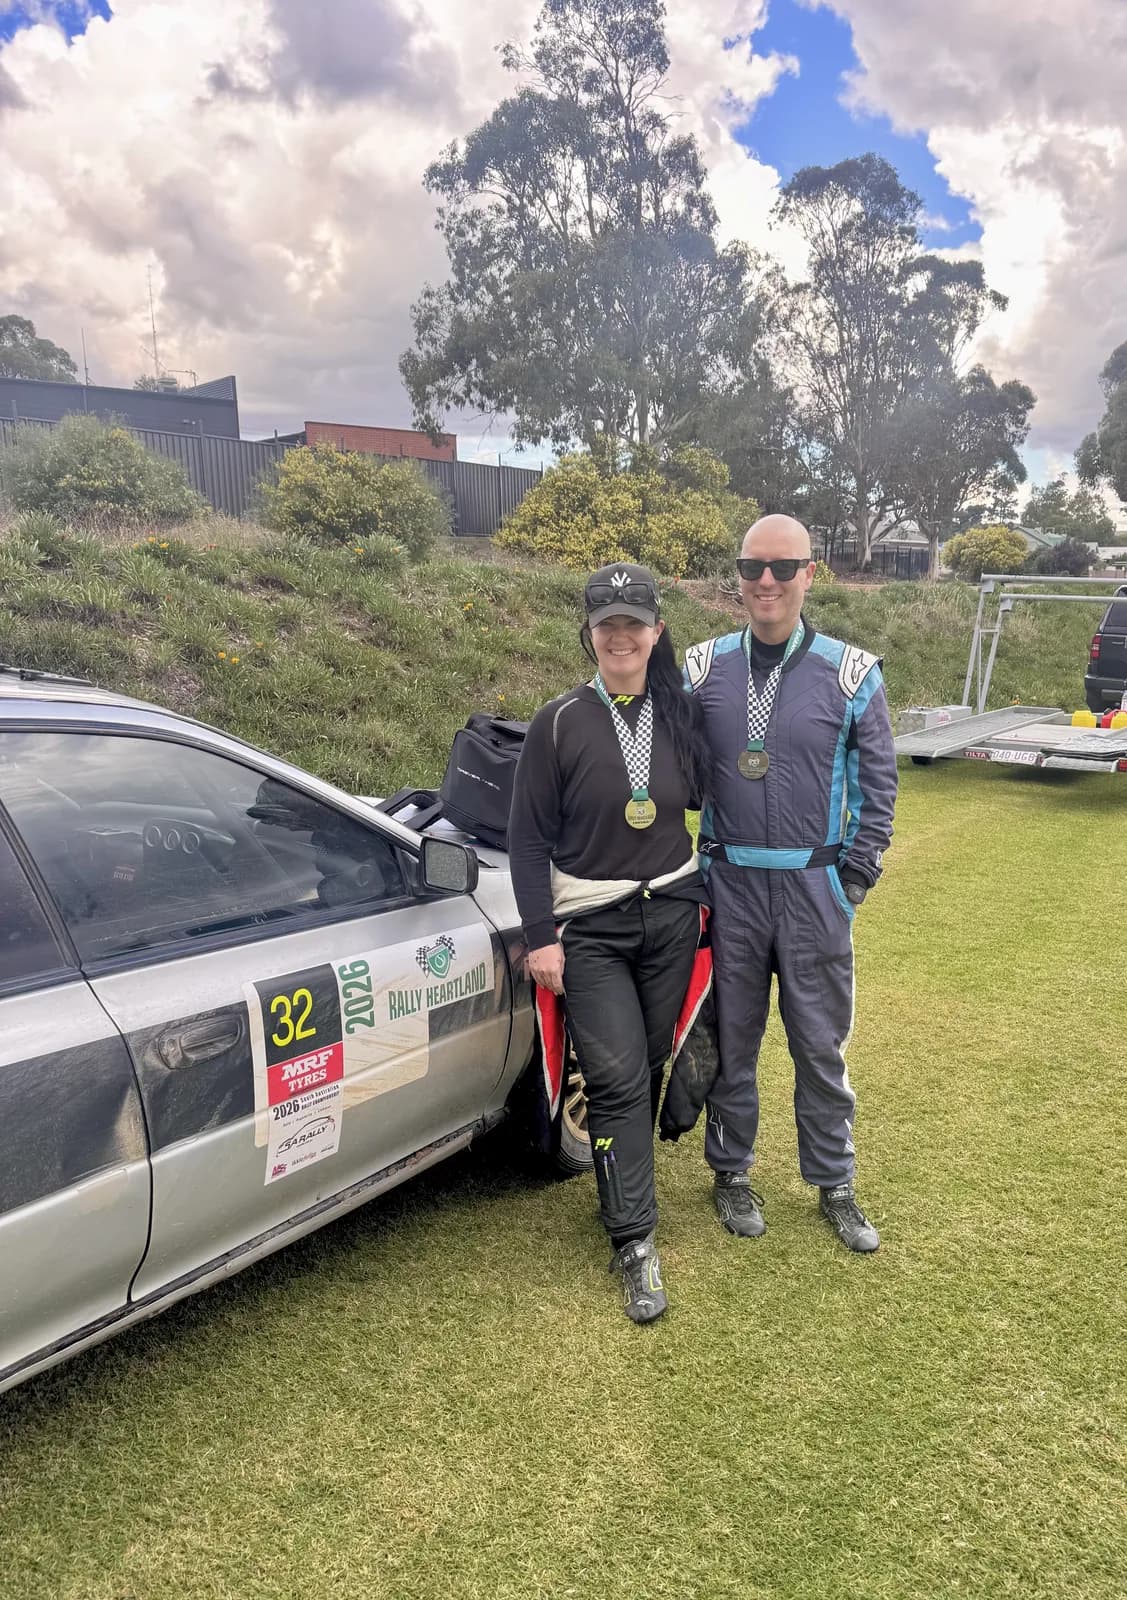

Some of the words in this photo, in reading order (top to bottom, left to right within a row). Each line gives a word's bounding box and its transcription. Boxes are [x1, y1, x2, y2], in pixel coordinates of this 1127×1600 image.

[964, 751, 986, 759] TILTA
[338, 959, 376, 1035] 2026
[388, 988, 423, 1021] RALLY
[426, 962, 486, 1008] HEARTLAND
[270, 987, 317, 1047] 32
[281, 1049, 333, 1081] MRF
[288, 1068, 327, 1092] TYRES
[273, 1099, 300, 1121] 2026
[594, 1137, 614, 1151] P1
